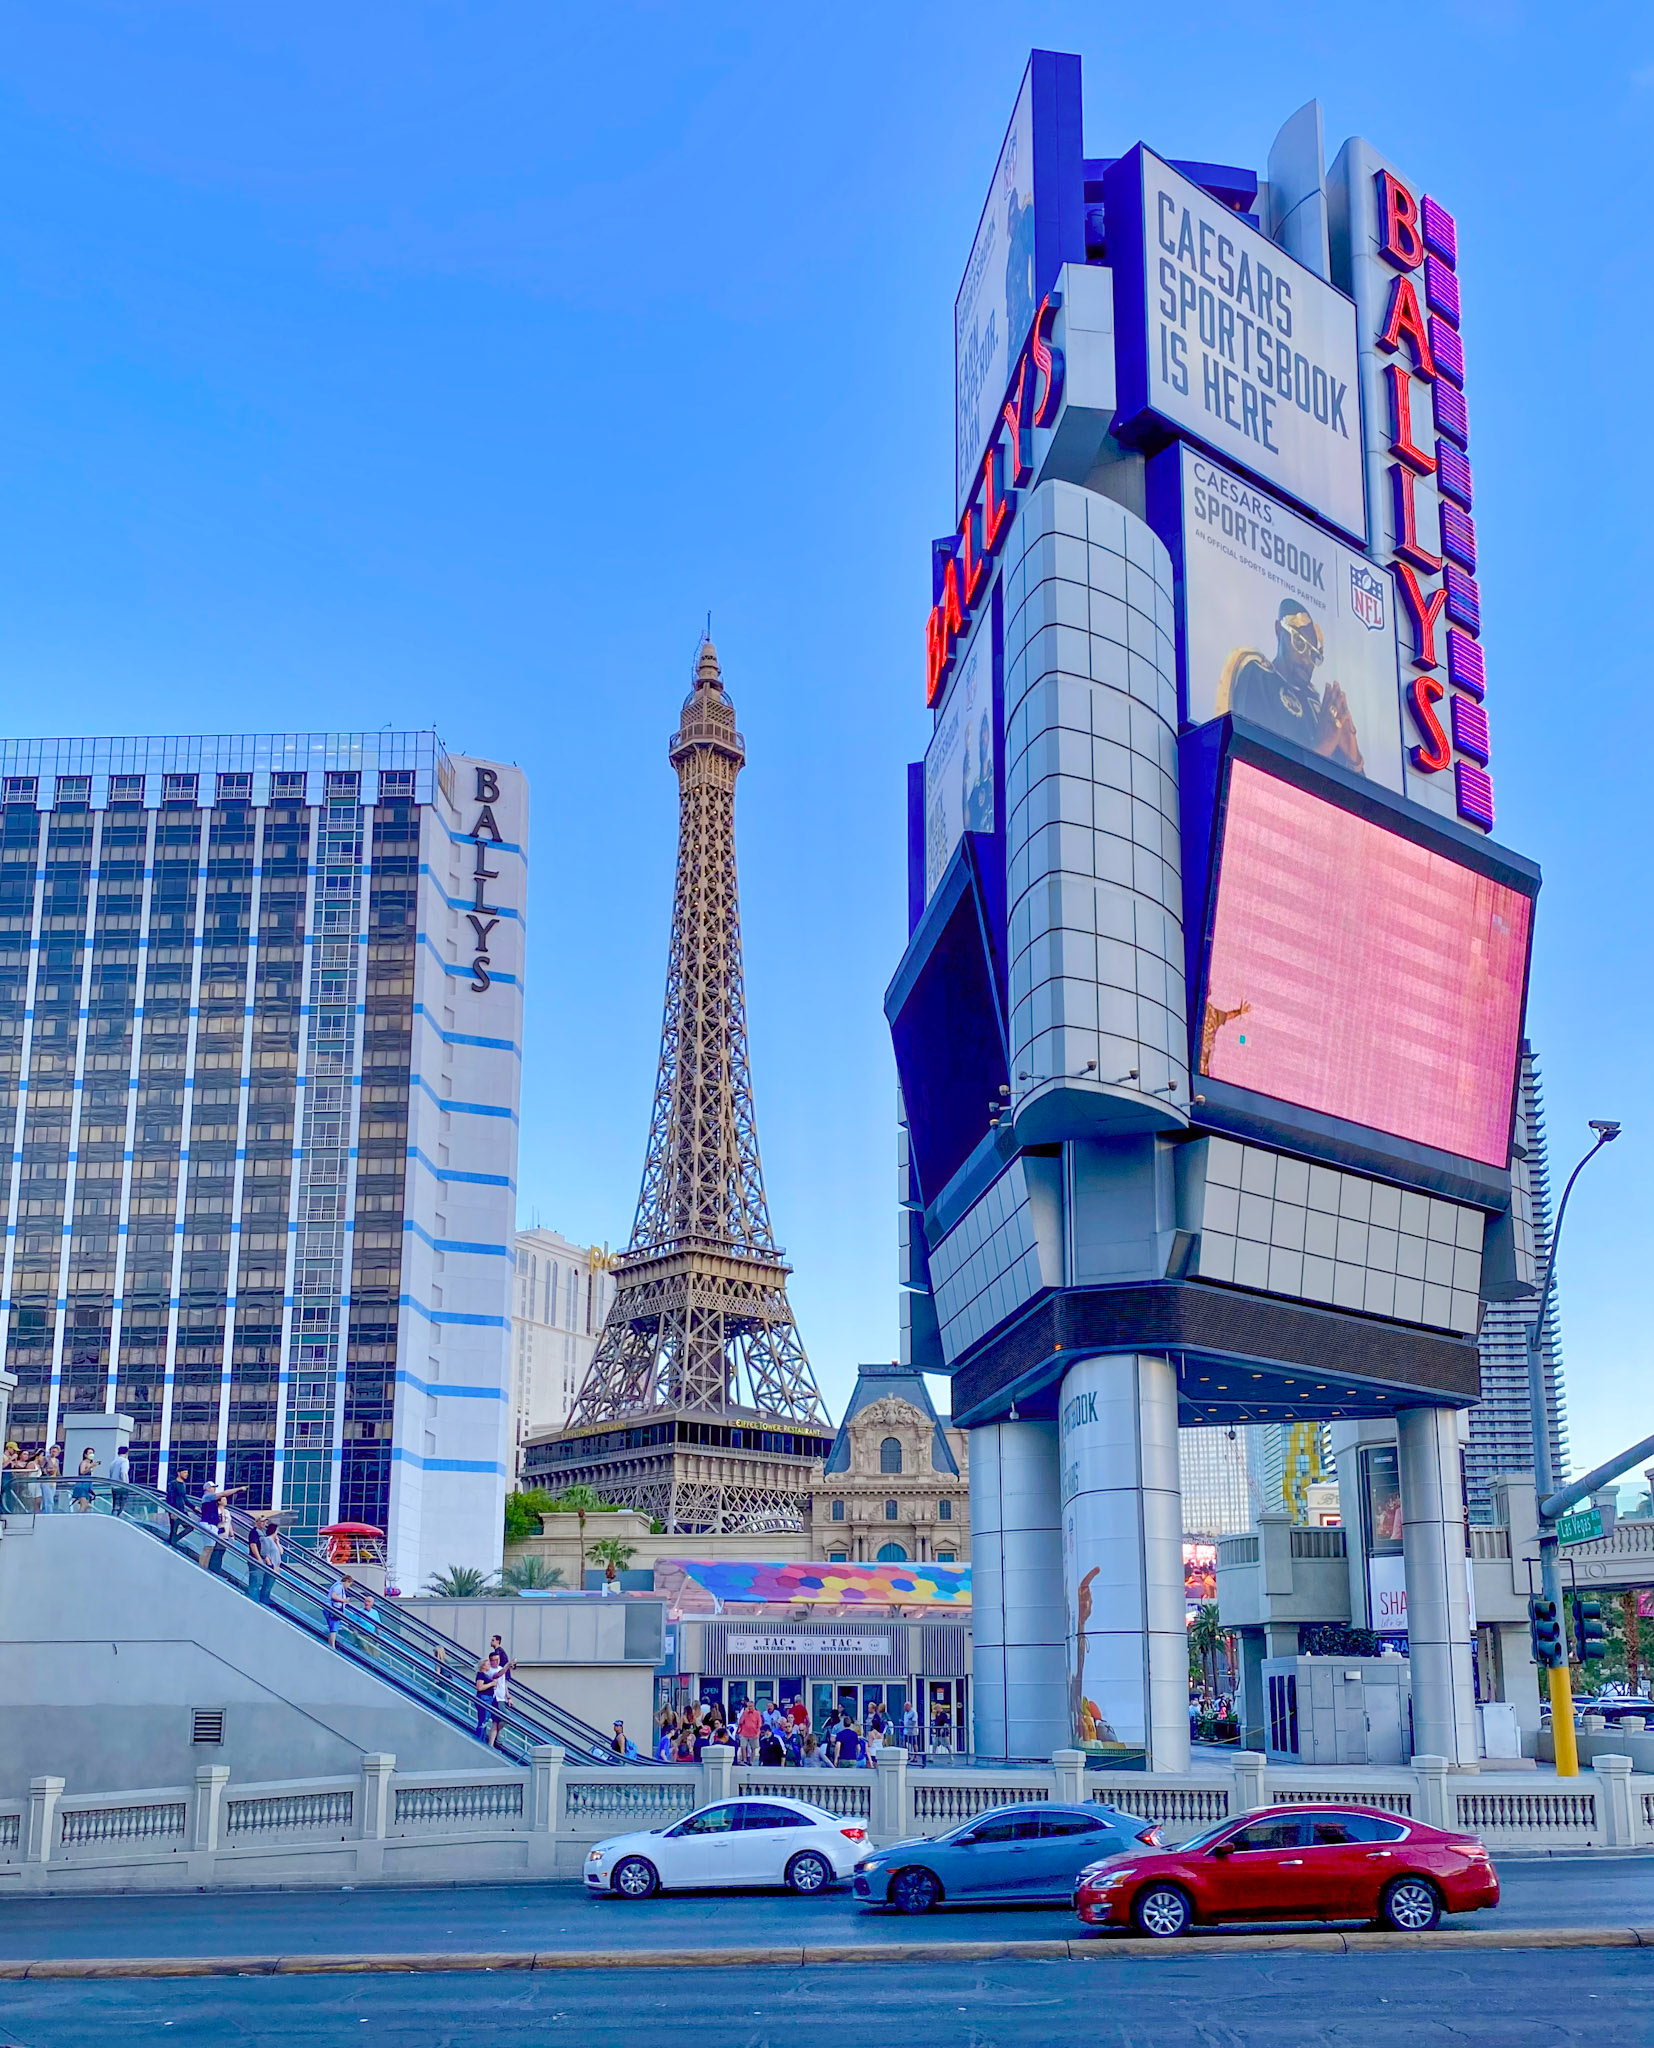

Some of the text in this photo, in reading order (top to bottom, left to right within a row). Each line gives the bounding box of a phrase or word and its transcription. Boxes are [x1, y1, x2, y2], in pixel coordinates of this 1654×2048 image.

[1157, 190, 1291, 338] CAESARS
[959, 312, 979, 407] EARN
[1158, 257, 1349, 440] SPORTSBOOK
[1160, 322, 1279, 455] IS HERE
[1193, 462, 1272, 523] CAESARS
[1374, 168, 1450, 774] BALLYS
[1194, 486, 1326, 591] SPORTSBOOK
[1195, 529, 1327, 610] AN OFFICIAL SPORTS BETTING PARTNER
[1353, 587, 1382, 625] NFL
[466, 766, 503, 993] BALLYS
[758, 1421, 781, 1432] TOWER
[1560, 1520, 1572, 1538] Las
[1571, 1516, 1592, 1538] Vegas
[764, 1638, 786, 1646] TAC
[831, 1638, 853, 1647] TAC
[703, 1687, 719, 1695] OPEN
